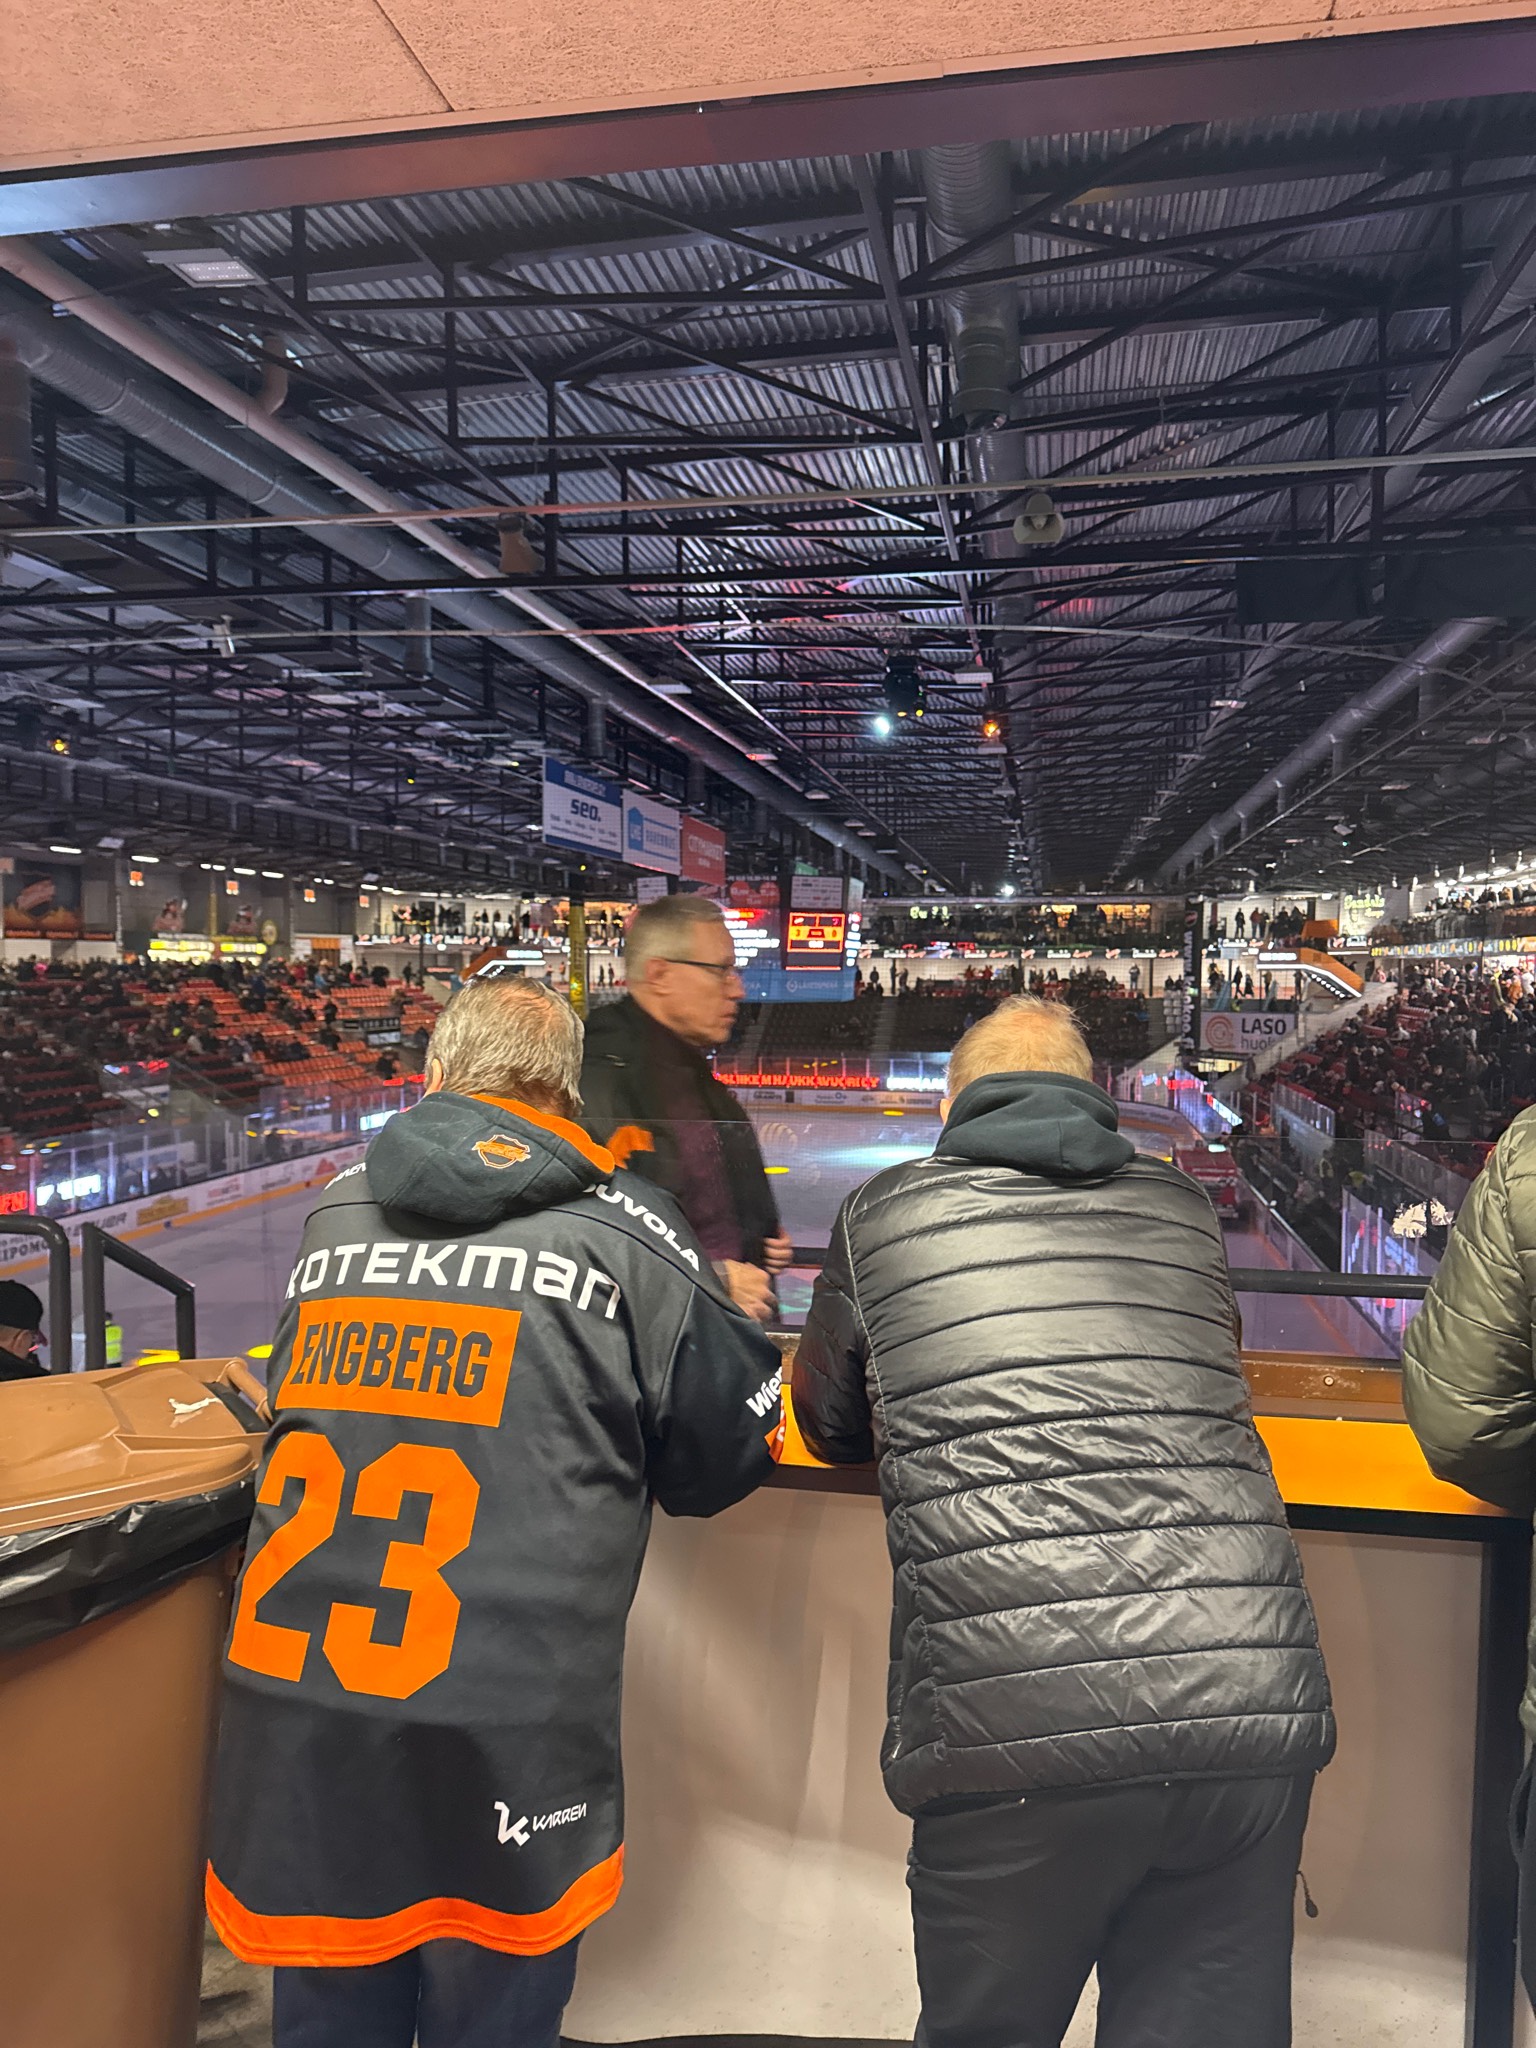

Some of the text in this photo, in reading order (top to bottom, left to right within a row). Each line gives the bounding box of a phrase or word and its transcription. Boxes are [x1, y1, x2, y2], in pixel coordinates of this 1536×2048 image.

[1241, 1018, 1286, 1035] LASO
[583, 1184, 699, 1272] UVOLA
[290, 1321, 493, 1398] ENGBERG
[228, 1431, 480, 1700] 23
